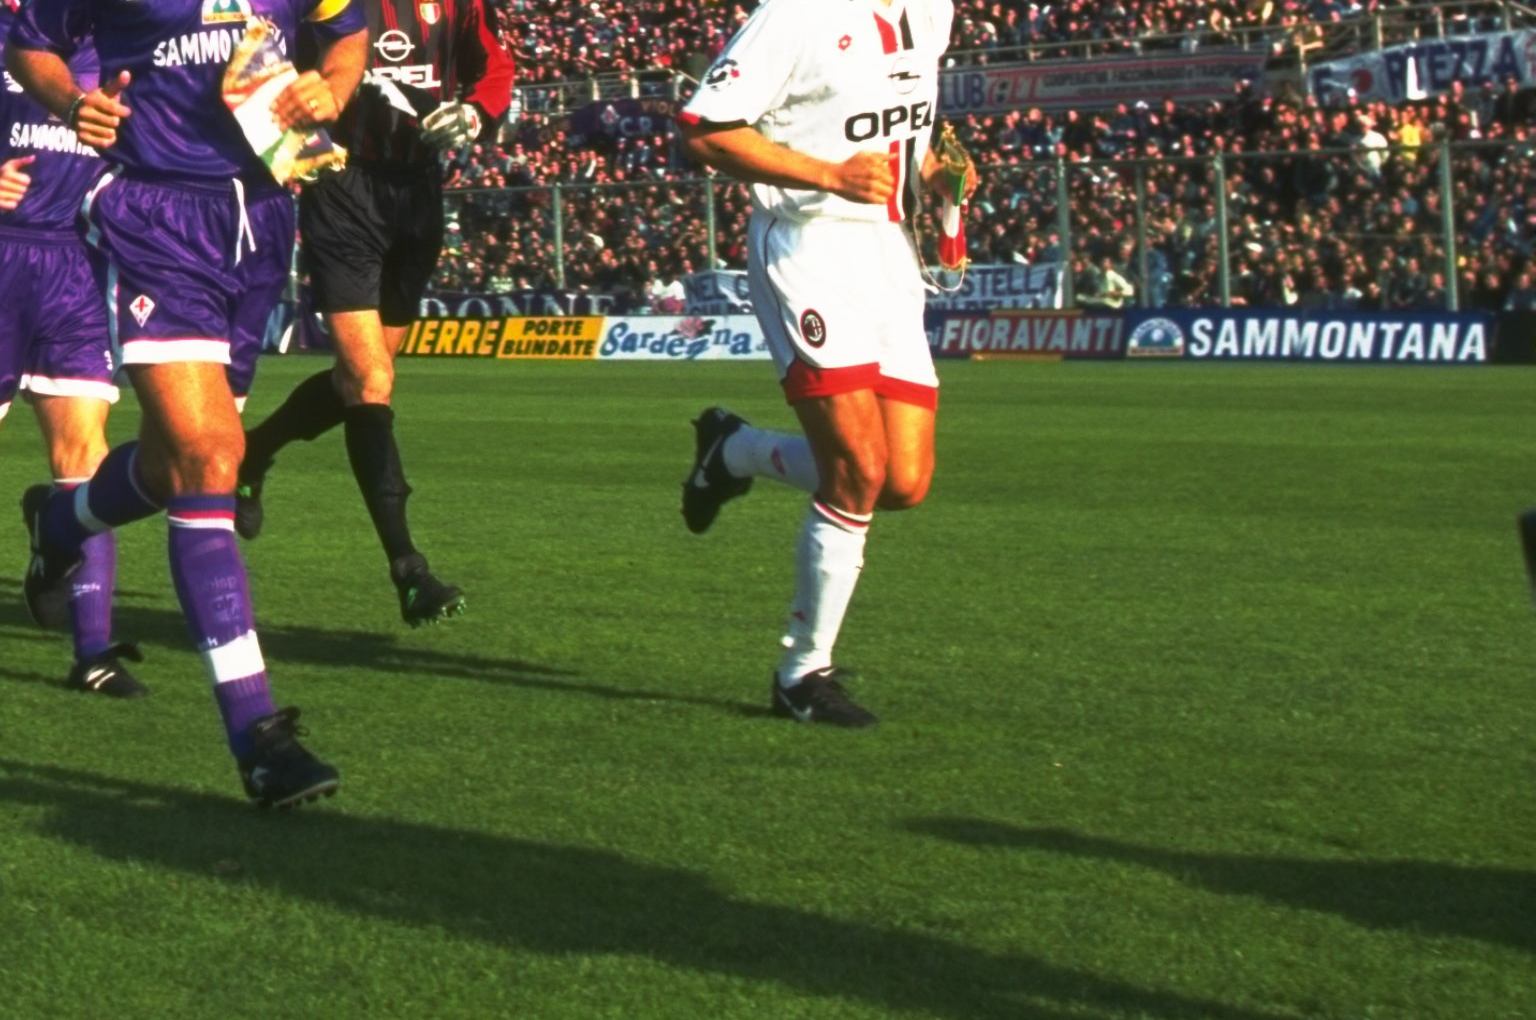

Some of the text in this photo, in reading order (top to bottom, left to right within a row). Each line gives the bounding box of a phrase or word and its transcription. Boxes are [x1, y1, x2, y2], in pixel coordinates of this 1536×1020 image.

[366, 64, 441, 89] PEL
[941, 74, 985, 110] LUB
[400, 320, 500, 355] IERRE
[522, 320, 584, 336] PORTE
[941, 318, 1124, 351] FIORAVANTI
[1189, 317, 1487, 361] SAMMONTANA
[502, 339, 595, 356] BLINDATE
